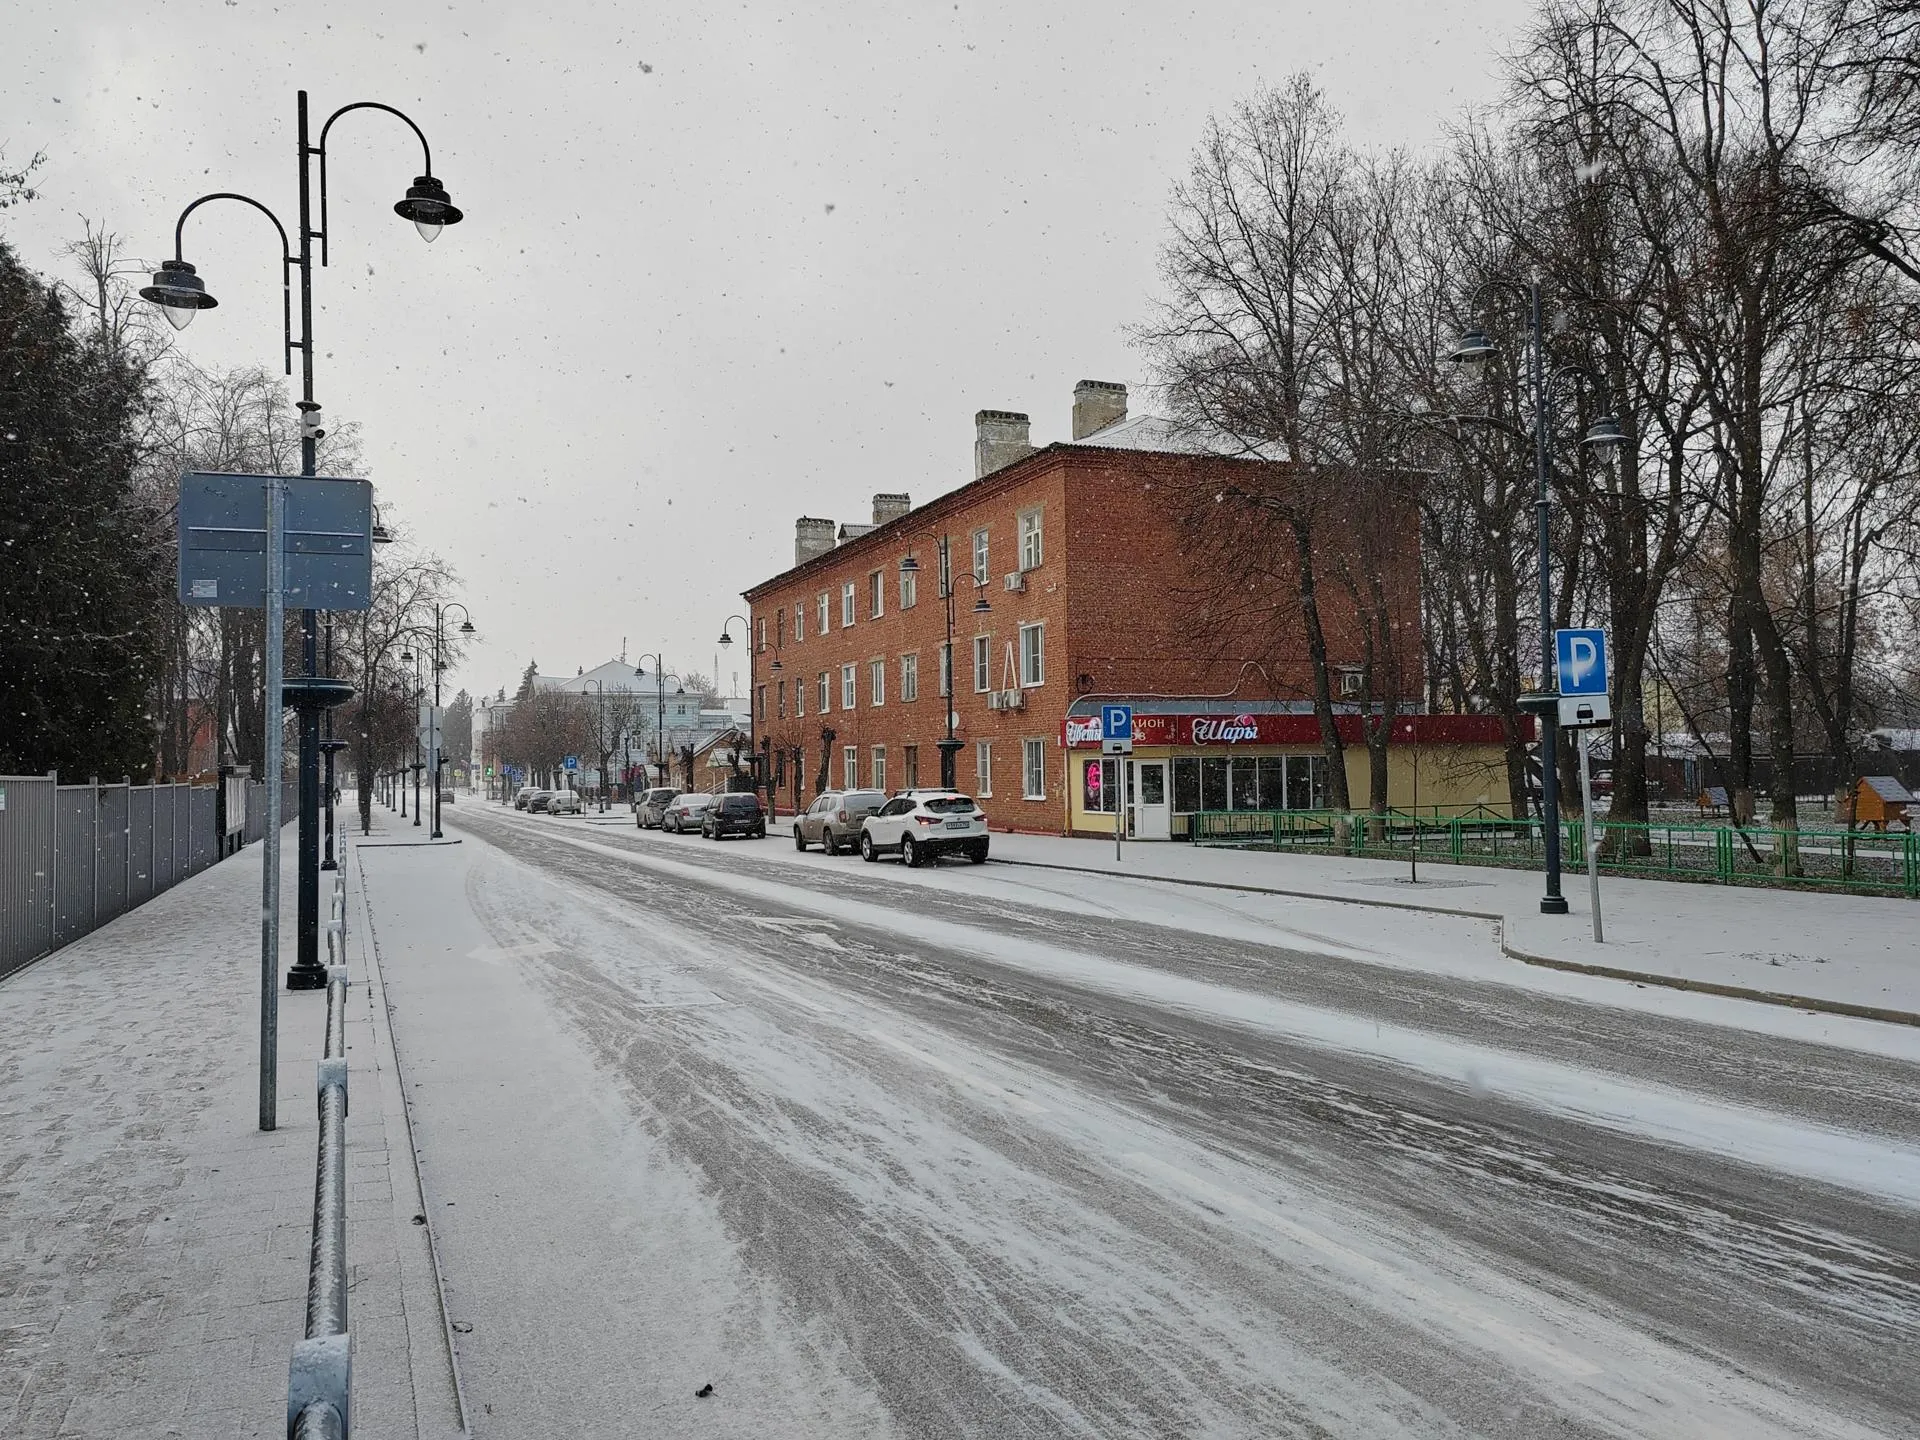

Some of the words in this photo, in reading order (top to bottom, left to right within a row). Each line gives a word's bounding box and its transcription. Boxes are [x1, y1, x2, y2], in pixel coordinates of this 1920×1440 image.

[1570, 637, 1597, 688] P
[1110, 709, 1127, 735] P
[1192, 717, 1258, 746] Шары
[568, 758, 576, 769] P
